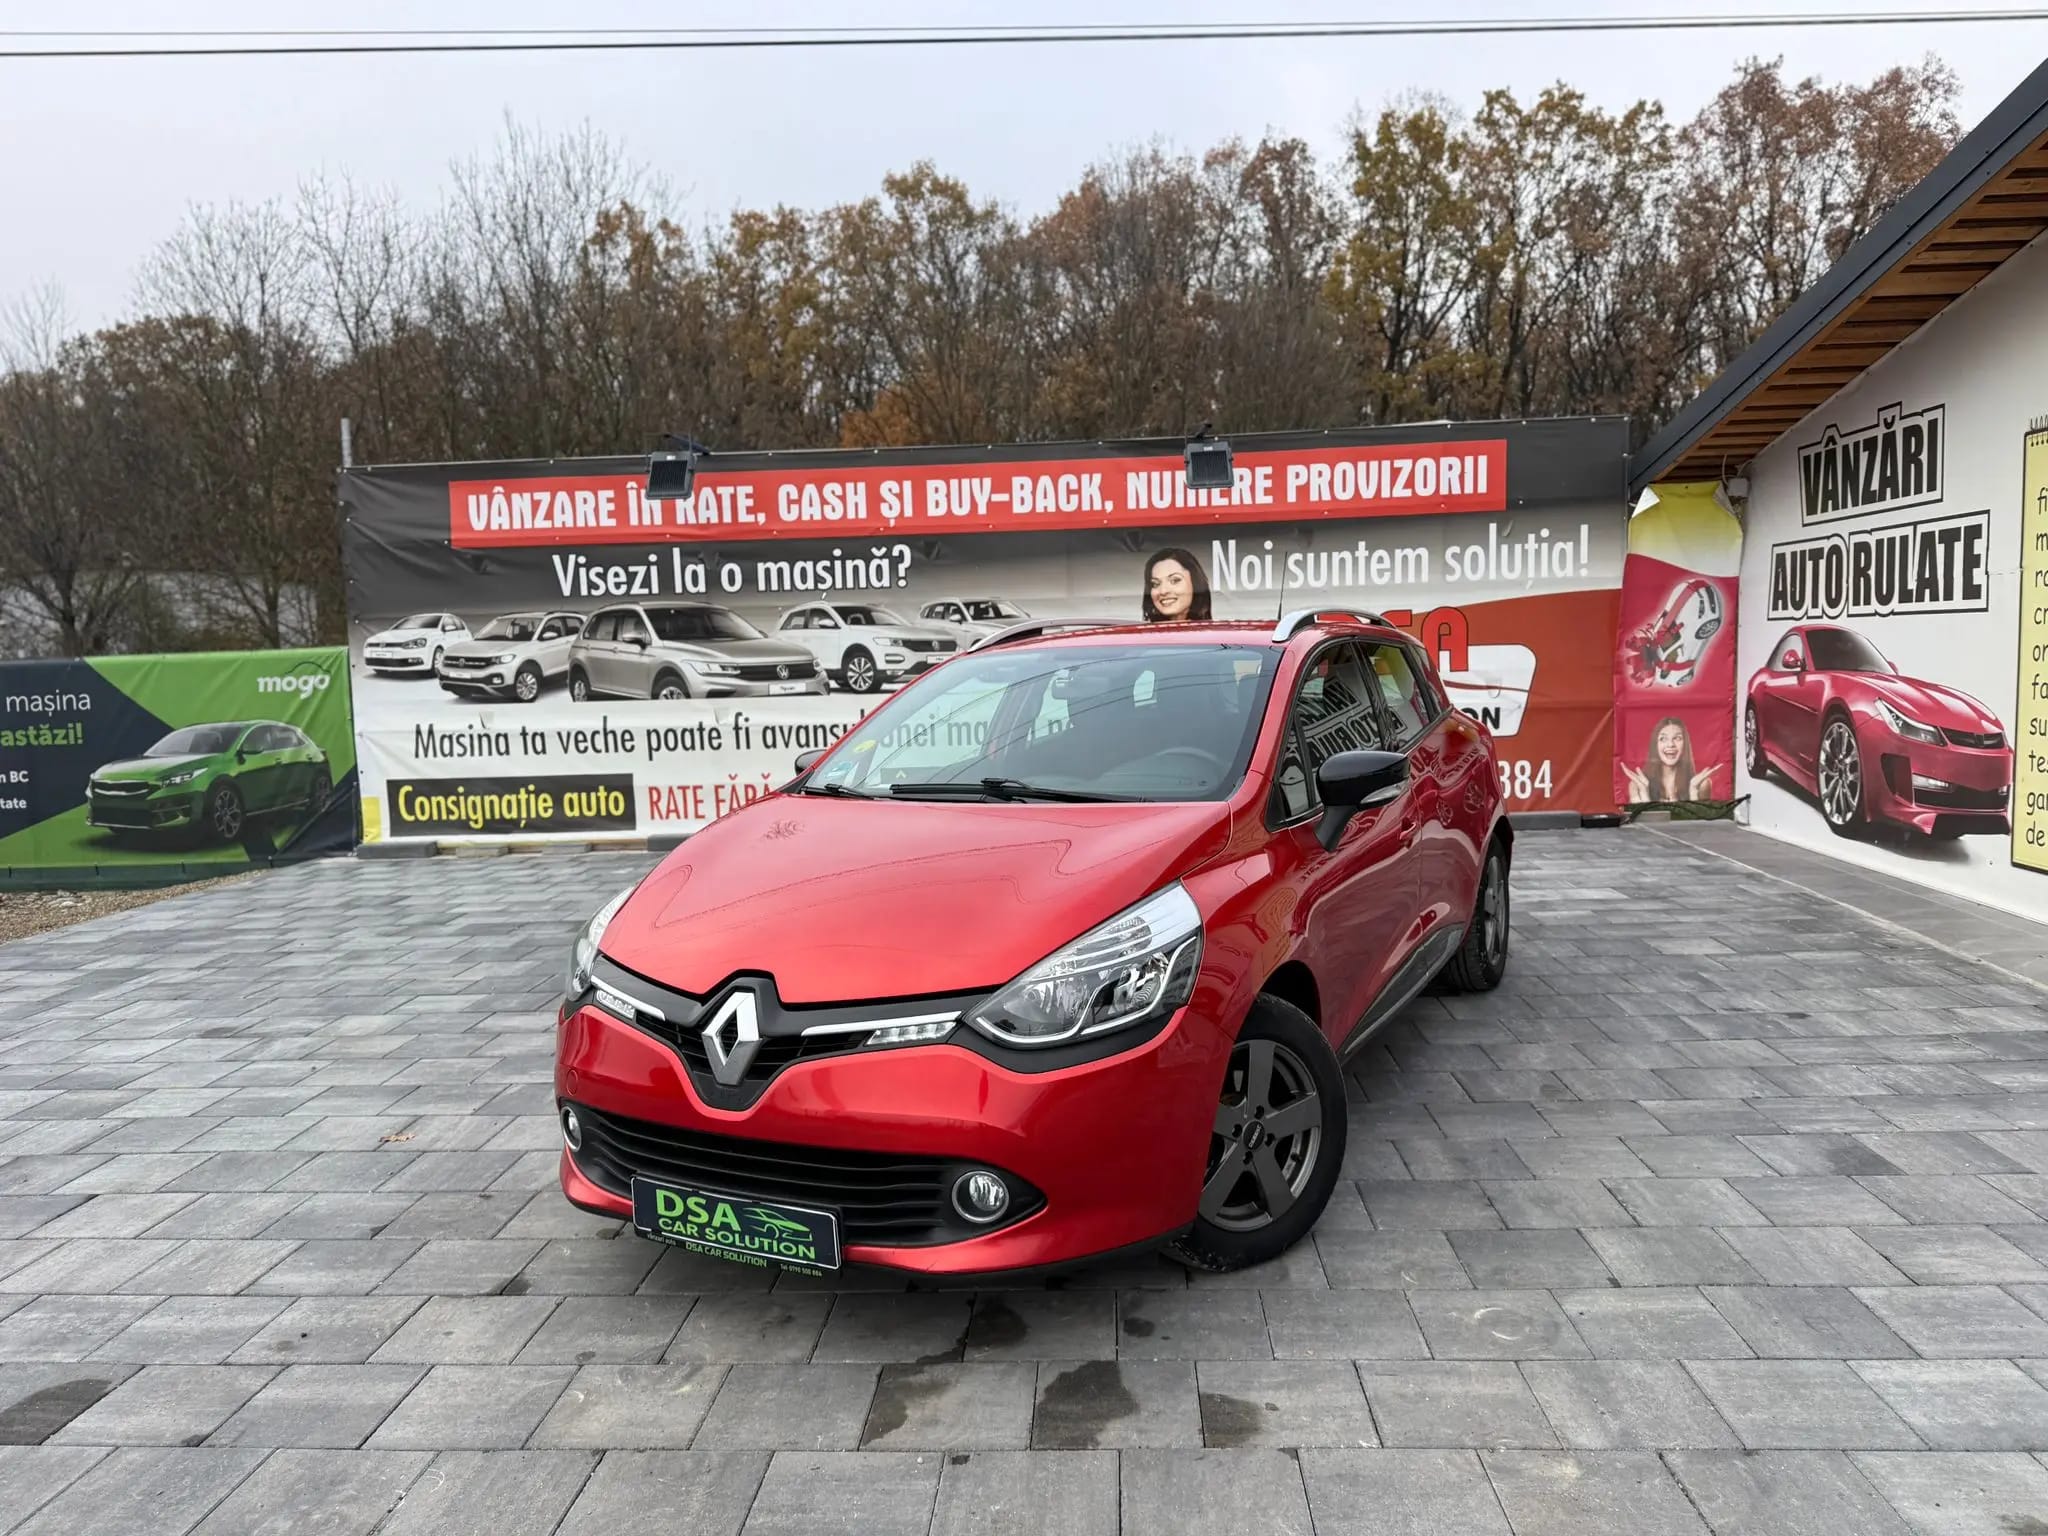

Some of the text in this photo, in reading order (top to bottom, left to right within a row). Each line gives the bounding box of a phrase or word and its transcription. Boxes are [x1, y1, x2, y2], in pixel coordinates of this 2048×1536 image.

[1802, 415, 1938, 517] VÂNZĂRI
[467, 486, 617, 531] VÂNZARE
[675, 485, 767, 527] RATE,
[777, 482, 868, 522] CASH
[879, 480, 913, 527] ȘI
[1286, 455, 1488, 503] PROVIZORII
[552, 543, 912, 600] Visezi la o mașină?
[1212, 523, 1589, 591] Noi suntem soluția!
[1772, 523, 1983, 612] AUTO RULATE
[6, 689, 91, 717] mașina
[256, 674, 331, 700] mogo
[0, 722, 83, 746] astăzi!
[519, 725, 547, 755] ta
[557, 715, 635, 755] veche
[646, 721, 722, 761] poate
[732, 712, 751, 750] fi
[10, 770, 29, 783] BC
[398, 784, 625, 829] Consignație auto
[648, 784, 705, 820] RATE
[656, 1188, 741, 1232] DSA
[658, 1218, 815, 1259] CAR SOLUTION
[685, 1241, 767, 1267] DSA CAR SOLUTION
